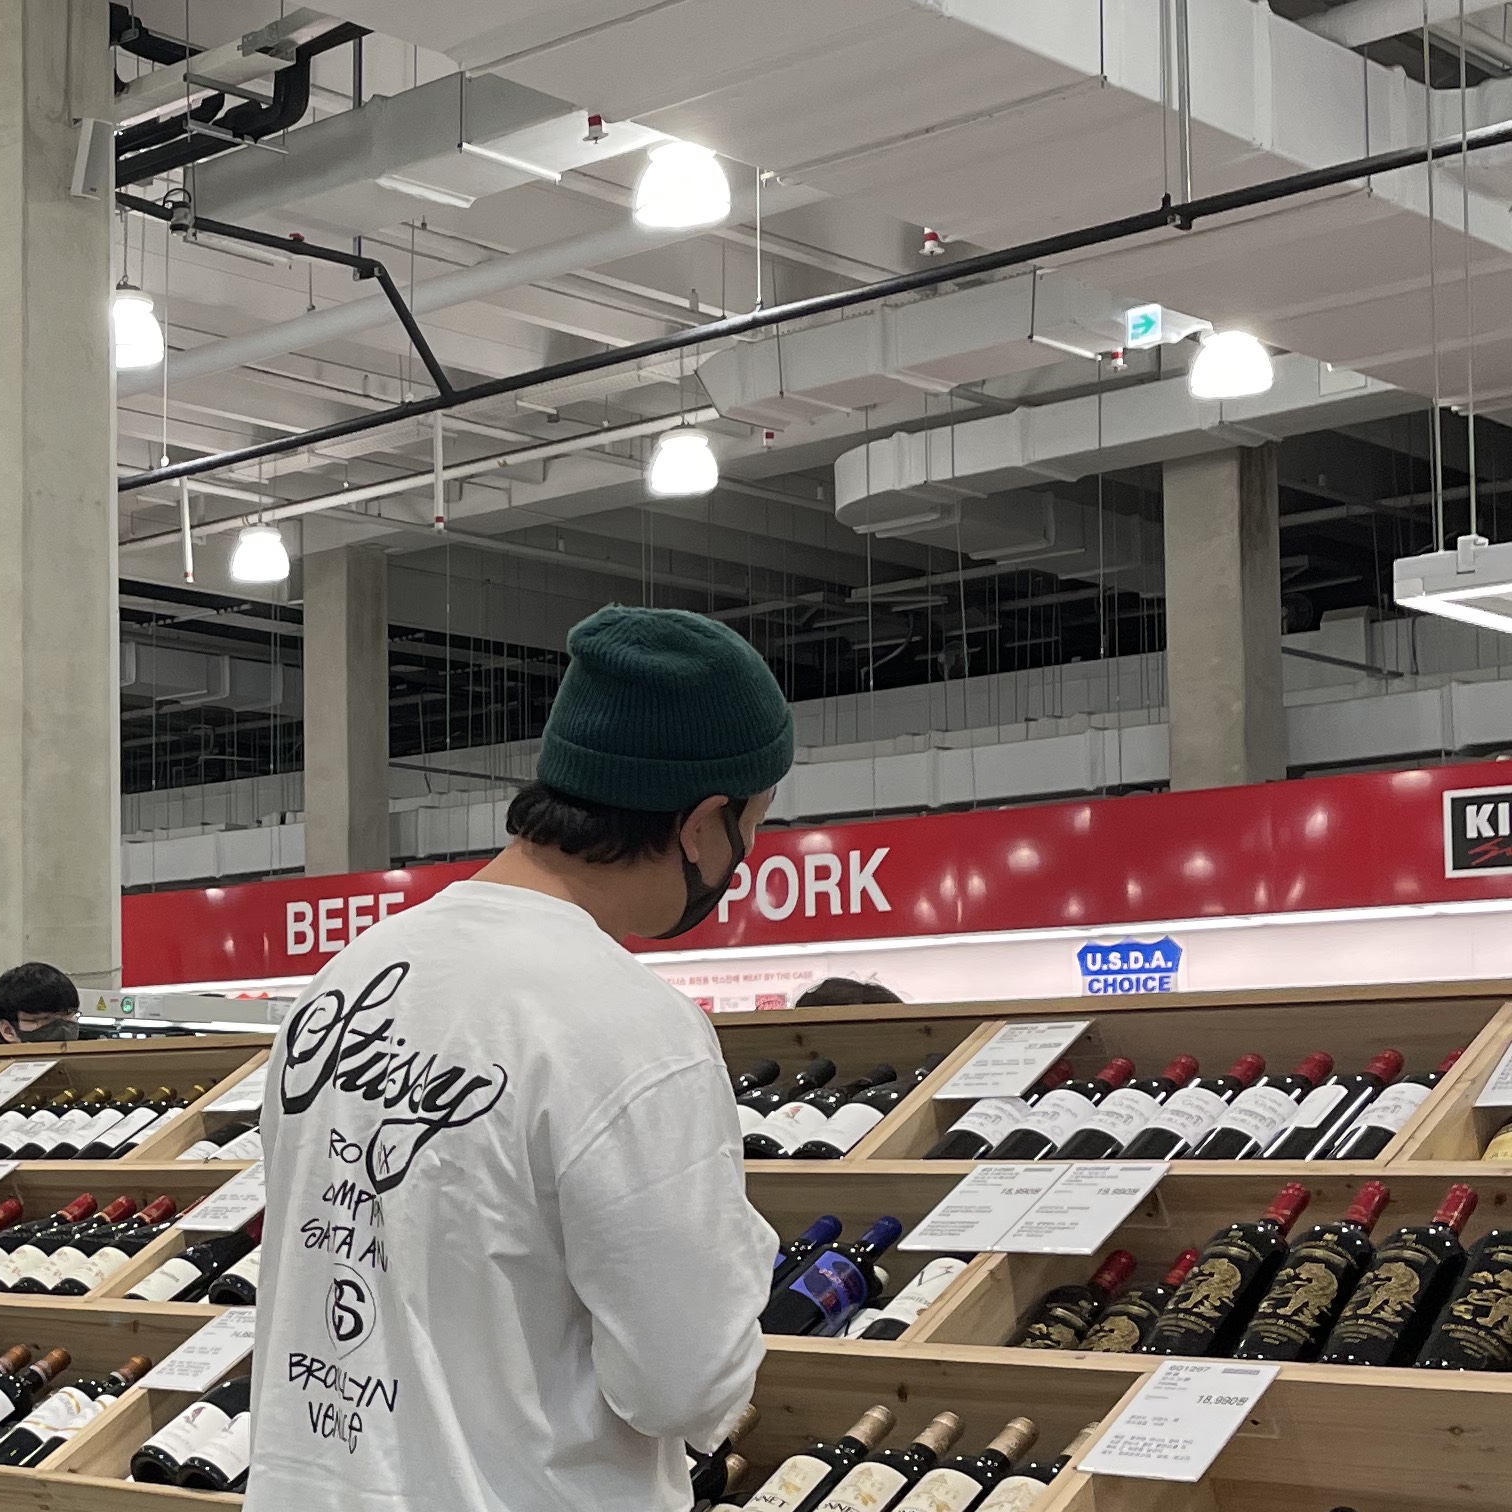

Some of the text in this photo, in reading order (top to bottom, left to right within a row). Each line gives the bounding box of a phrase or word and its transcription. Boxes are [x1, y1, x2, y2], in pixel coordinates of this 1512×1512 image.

[718, 848, 891, 923] PORK
[1086, 950, 1173, 971] U.S.D.A.
[742, 974, 762, 982] MEAT
[764, 973, 775, 981] BY
[776, 972, 791, 980] THE
[792, 971, 814, 979] CASE
[1088, 976, 1171, 994] CHOICE
